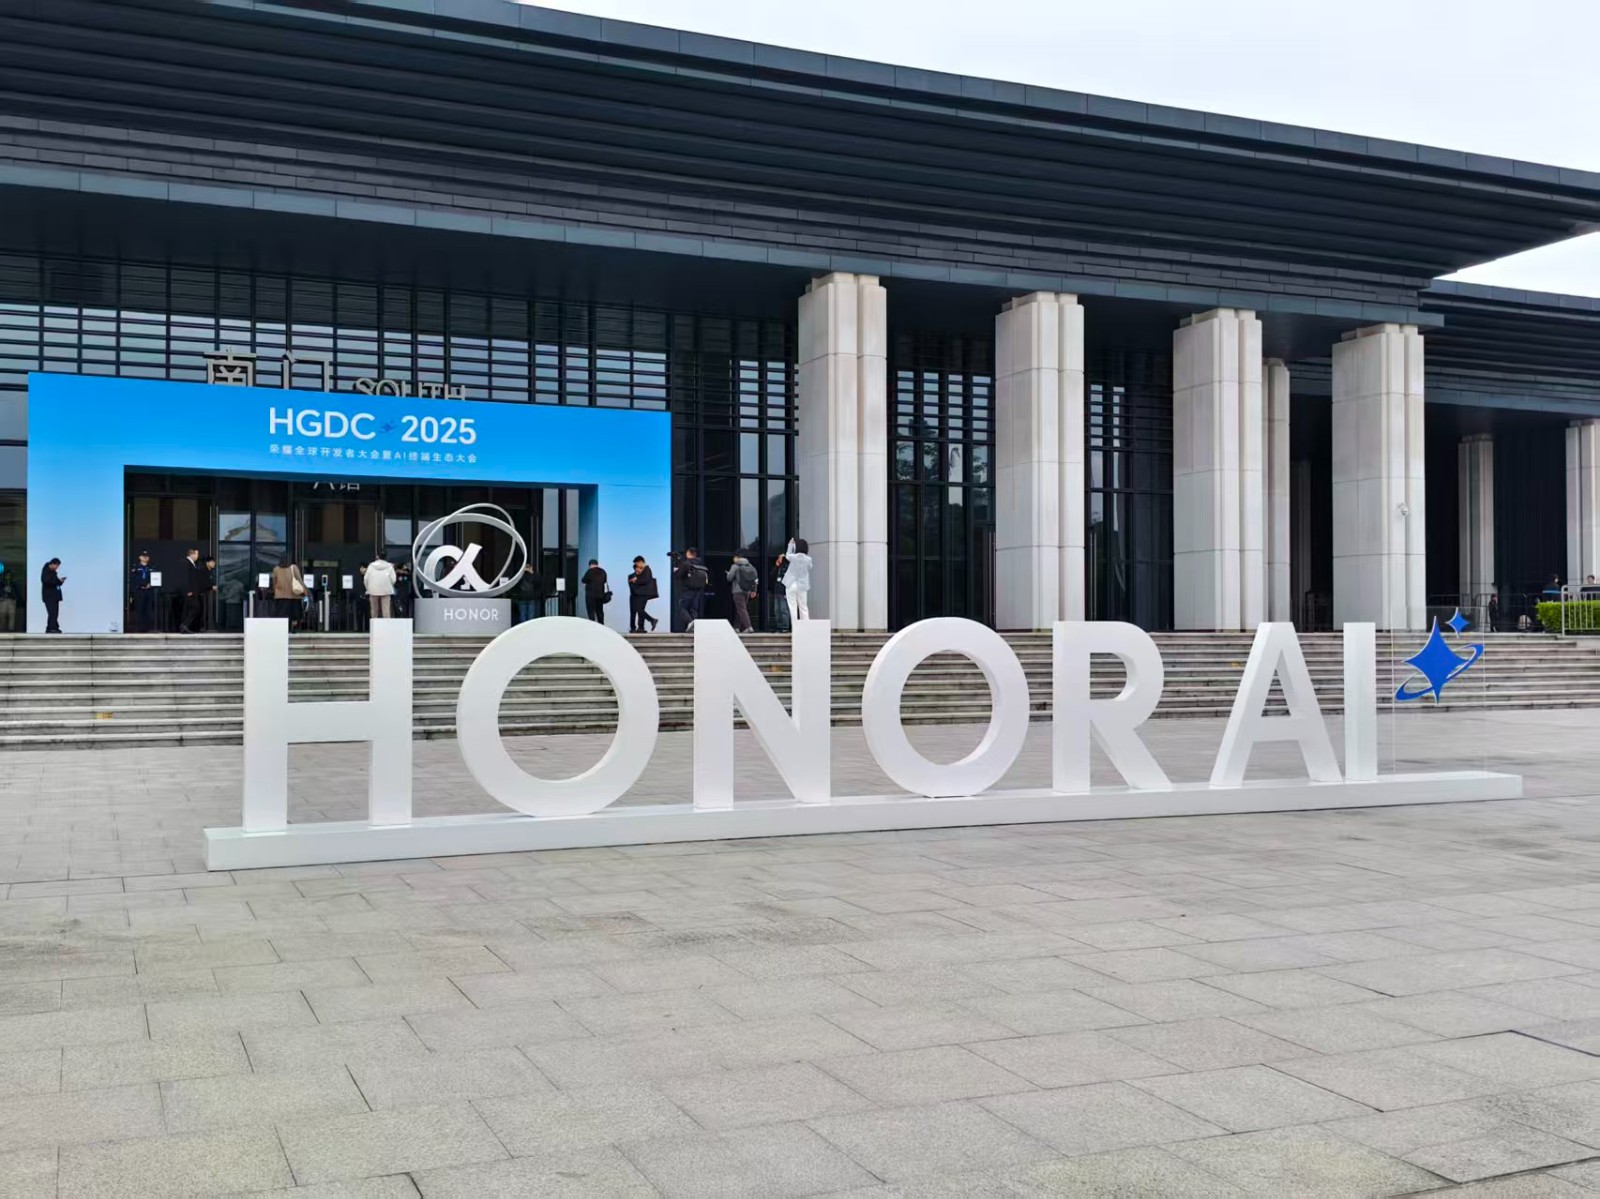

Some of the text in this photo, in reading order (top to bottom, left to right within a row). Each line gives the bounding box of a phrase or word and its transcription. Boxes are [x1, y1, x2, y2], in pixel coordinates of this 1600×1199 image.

[203, 348, 332, 392] 南门
[269, 407, 477, 445] HGDC 2025
[443, 608, 499, 621] HONOR
[242, 615, 1378, 833] HONOR AI
